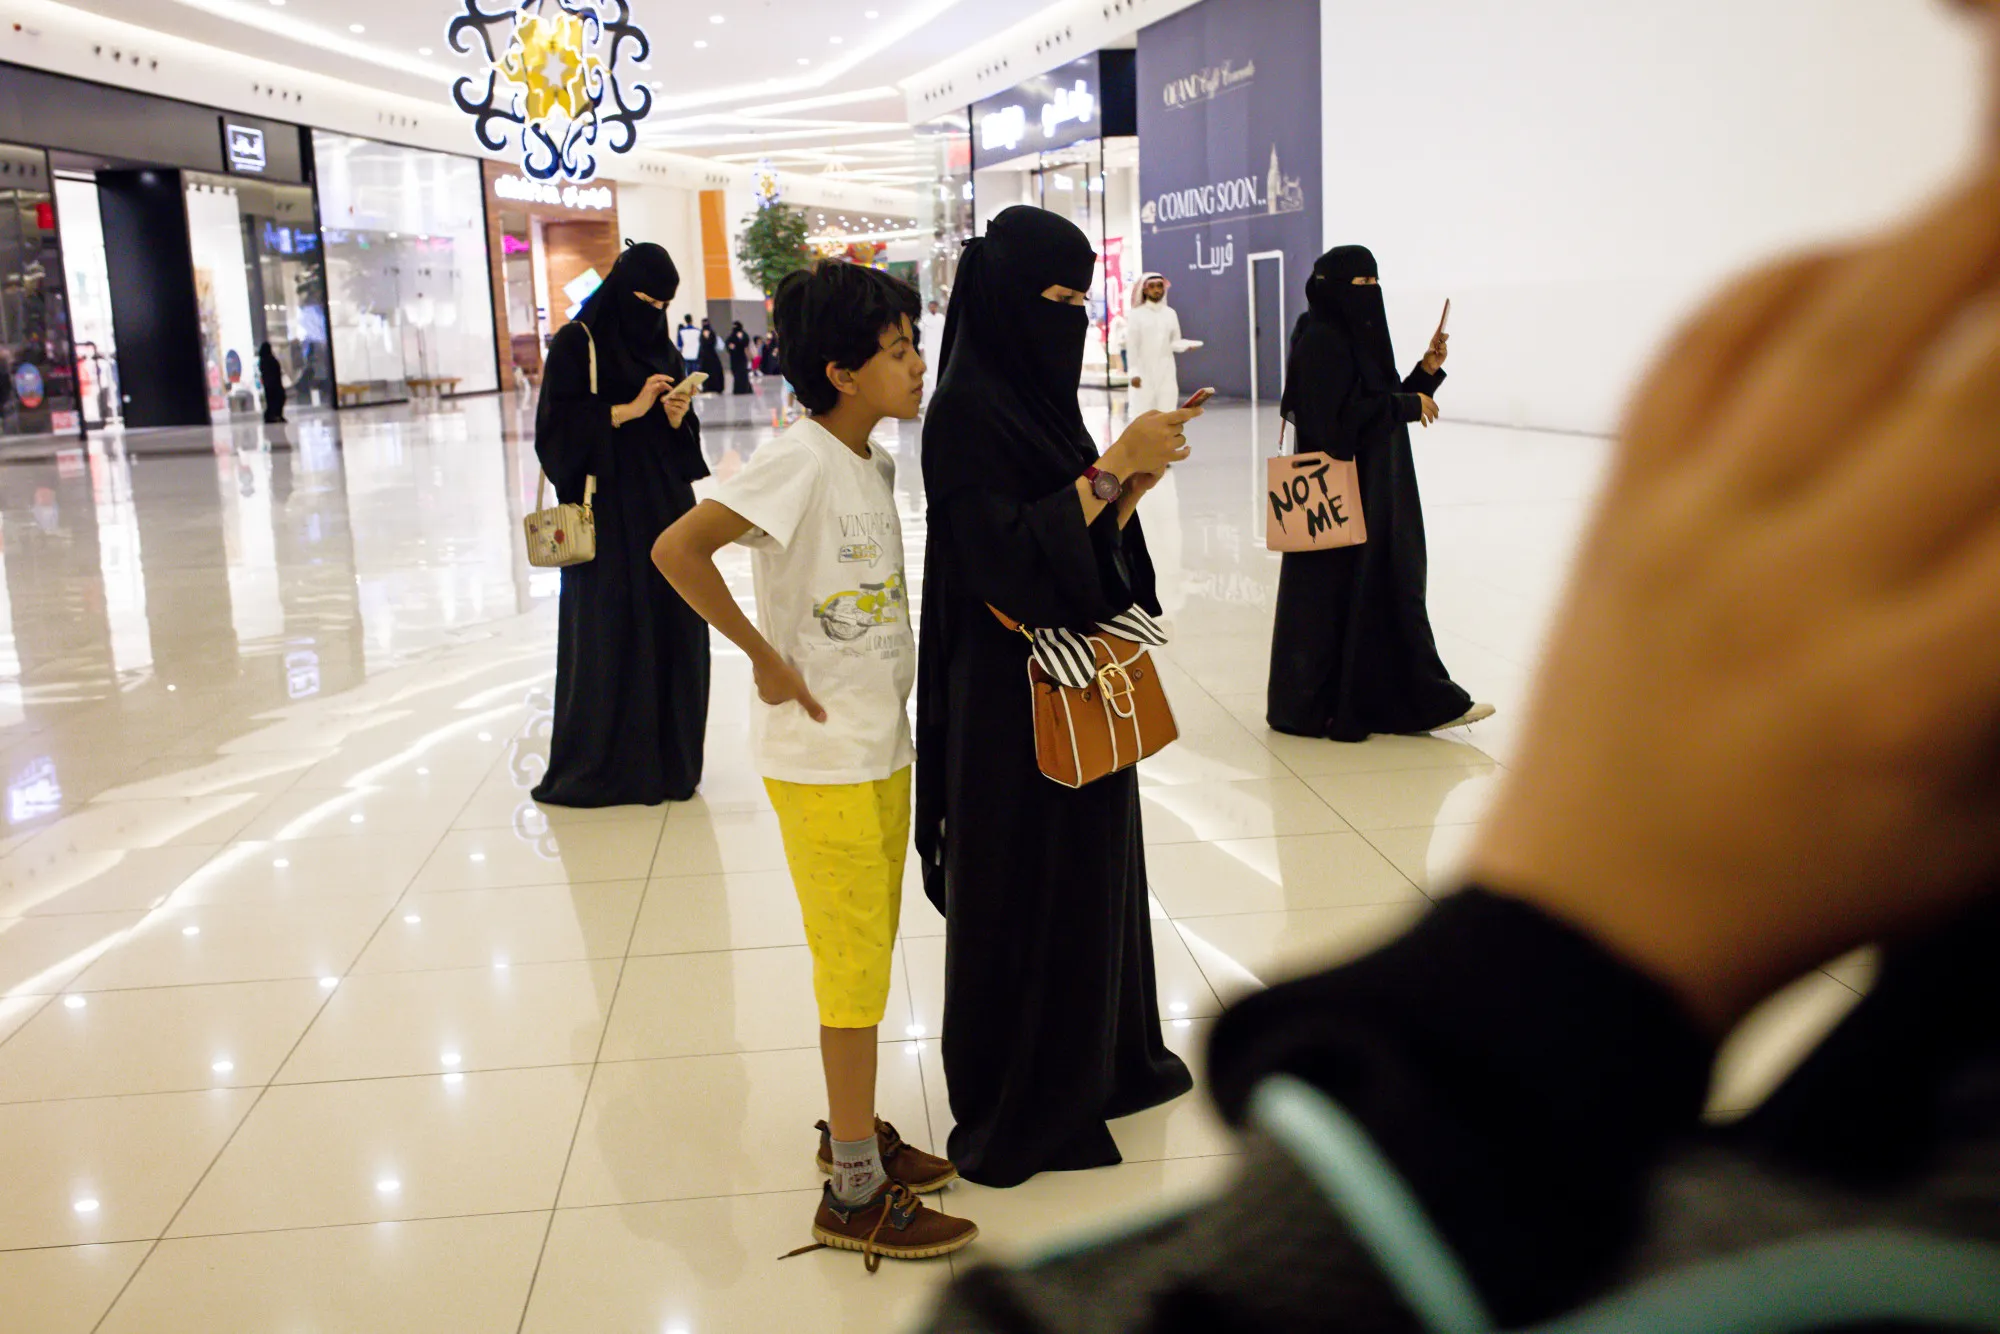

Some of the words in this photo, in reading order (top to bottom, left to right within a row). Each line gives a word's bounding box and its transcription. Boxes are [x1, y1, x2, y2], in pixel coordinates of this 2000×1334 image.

[1158, 184, 1214, 222] COMING
[1268, 463, 1330, 535] NOT
[1306, 494, 1349, 544] ME
